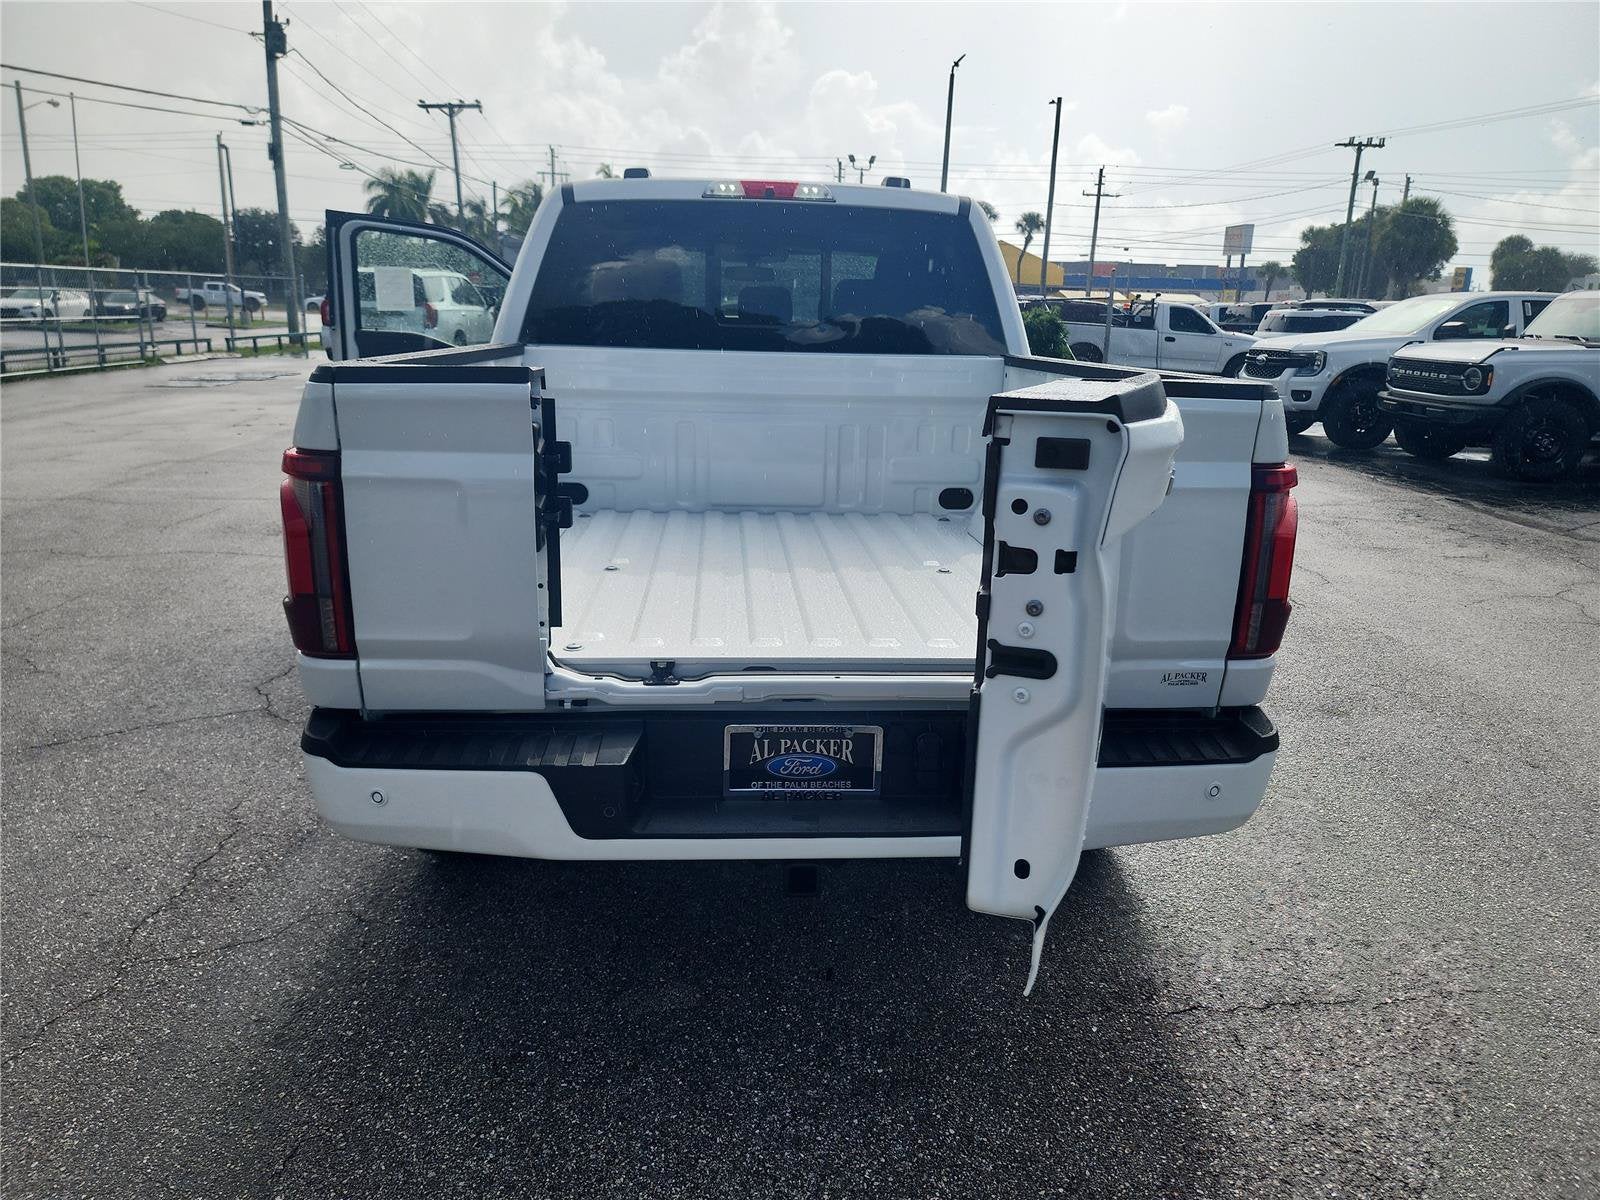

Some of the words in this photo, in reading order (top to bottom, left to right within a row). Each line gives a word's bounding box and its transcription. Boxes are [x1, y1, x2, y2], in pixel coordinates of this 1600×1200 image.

[1399, 369, 1448, 379] BRONCO
[1160, 672, 1172, 684] AL
[1174, 671, 1207, 683] PACKER
[749, 739, 775, 765] AL
[780, 739, 854, 765] PACKER
[780, 758, 823, 775] Ford
[751, 781, 764, 789] OF
[765, 781, 782, 789] THE
[784, 781, 808, 789] PALM
[810, 781, 852, 789] BEACHES
